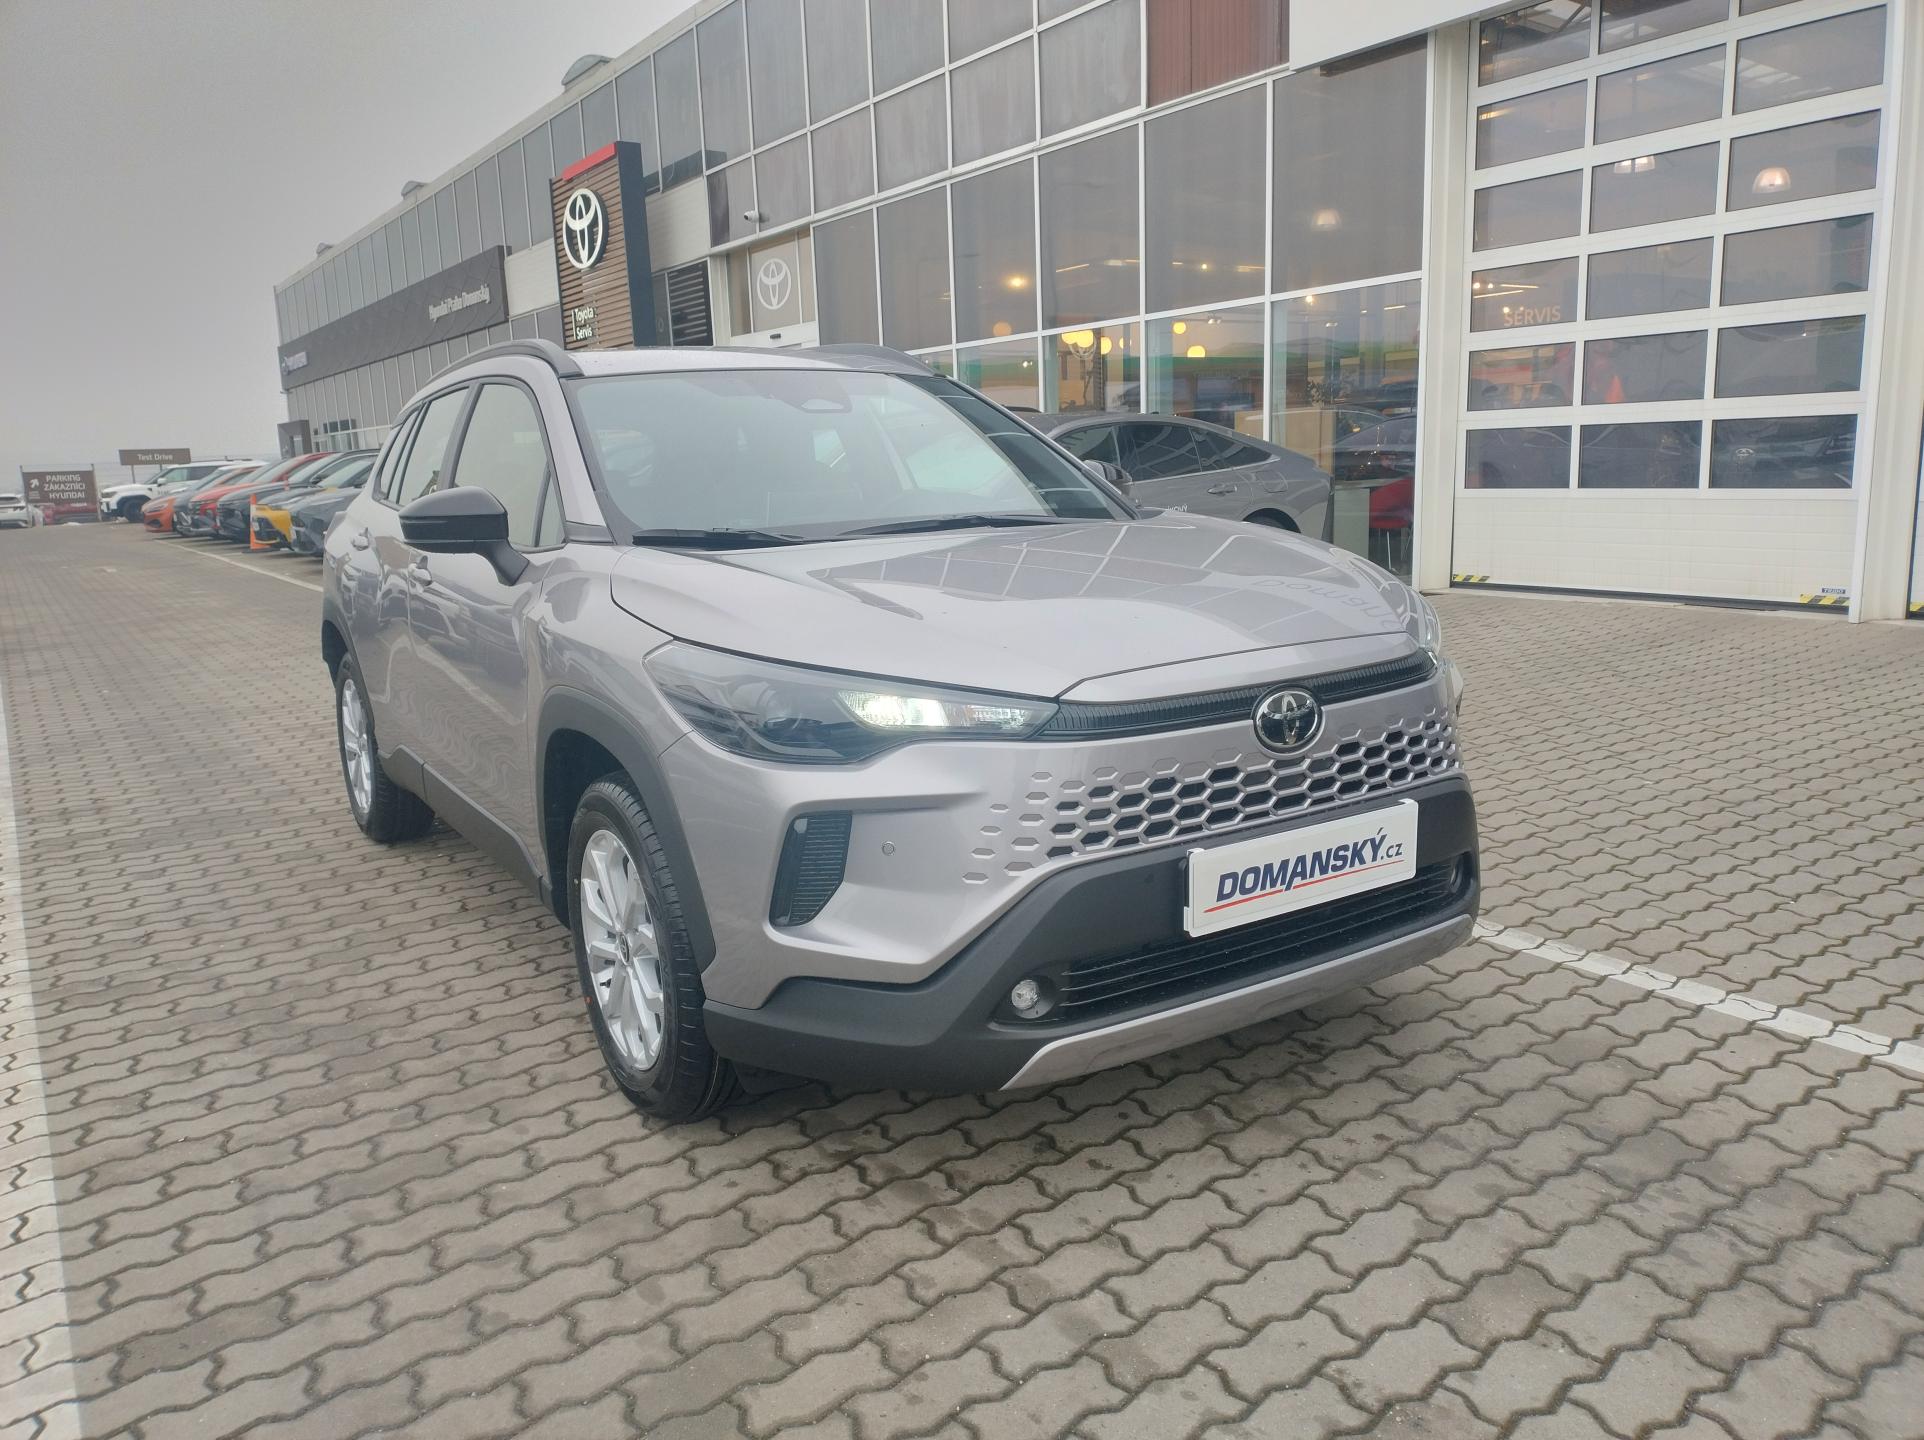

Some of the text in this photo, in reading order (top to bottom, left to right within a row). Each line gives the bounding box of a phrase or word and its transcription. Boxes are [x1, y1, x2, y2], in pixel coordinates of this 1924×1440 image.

[574, 306, 594, 324] Toyota
[1503, 306, 1561, 327] SERVIS
[576, 324, 593, 340] Servis
[137, 453, 173, 461] Test Drive
[46, 474, 81, 482] PARKING
[49, 491, 85, 500] HYUNDAI
[1215, 826, 1404, 903] DOMANSKÝ.cz
